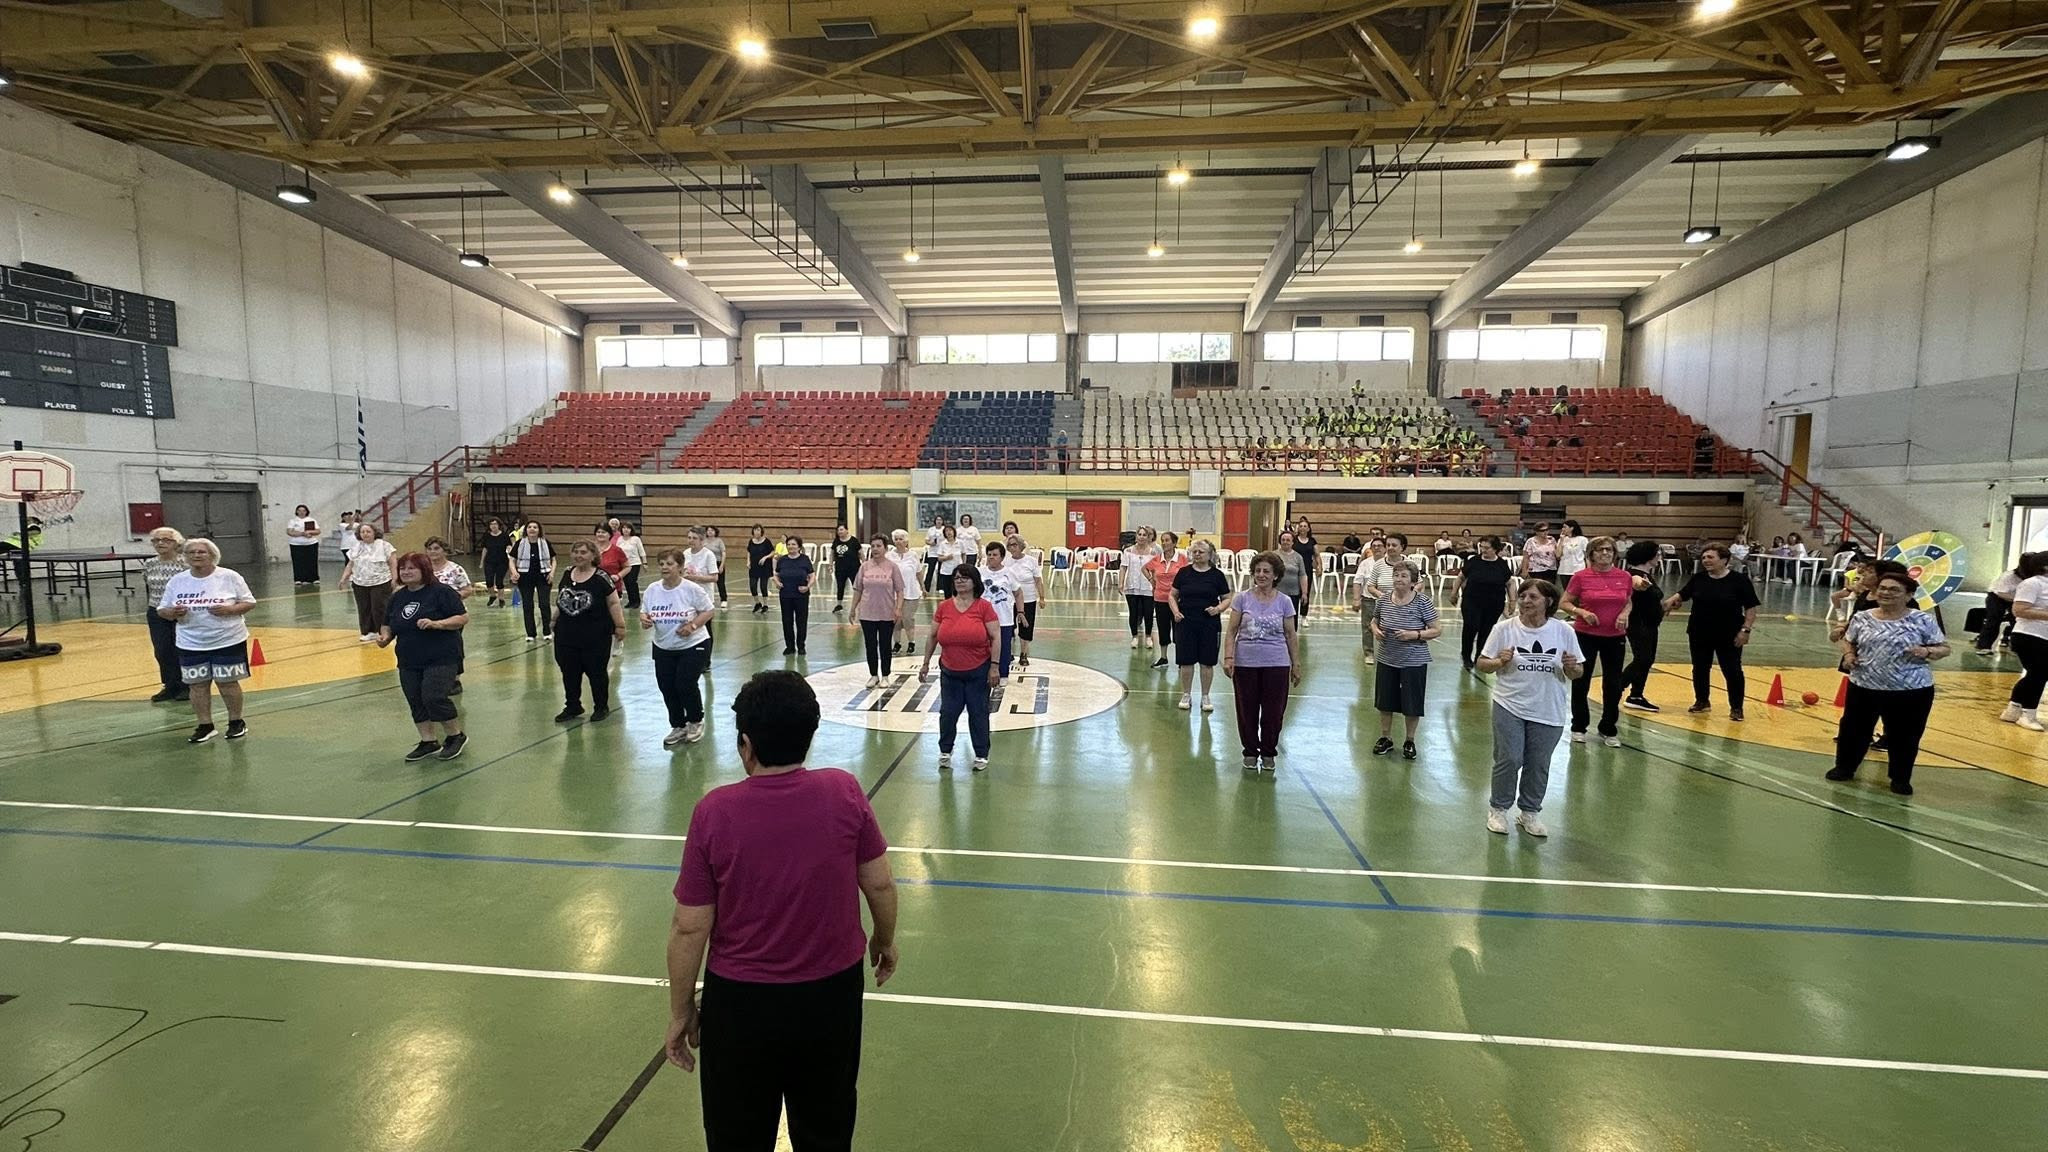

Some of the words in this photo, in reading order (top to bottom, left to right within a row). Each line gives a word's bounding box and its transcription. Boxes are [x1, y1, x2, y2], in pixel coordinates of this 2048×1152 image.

[100, 381, 126, 389] GUEST
[44, 401, 77, 410] PLAYER
[111, 407, 135, 415] FOULS
[175, 598, 225, 606] OLYMPICS
